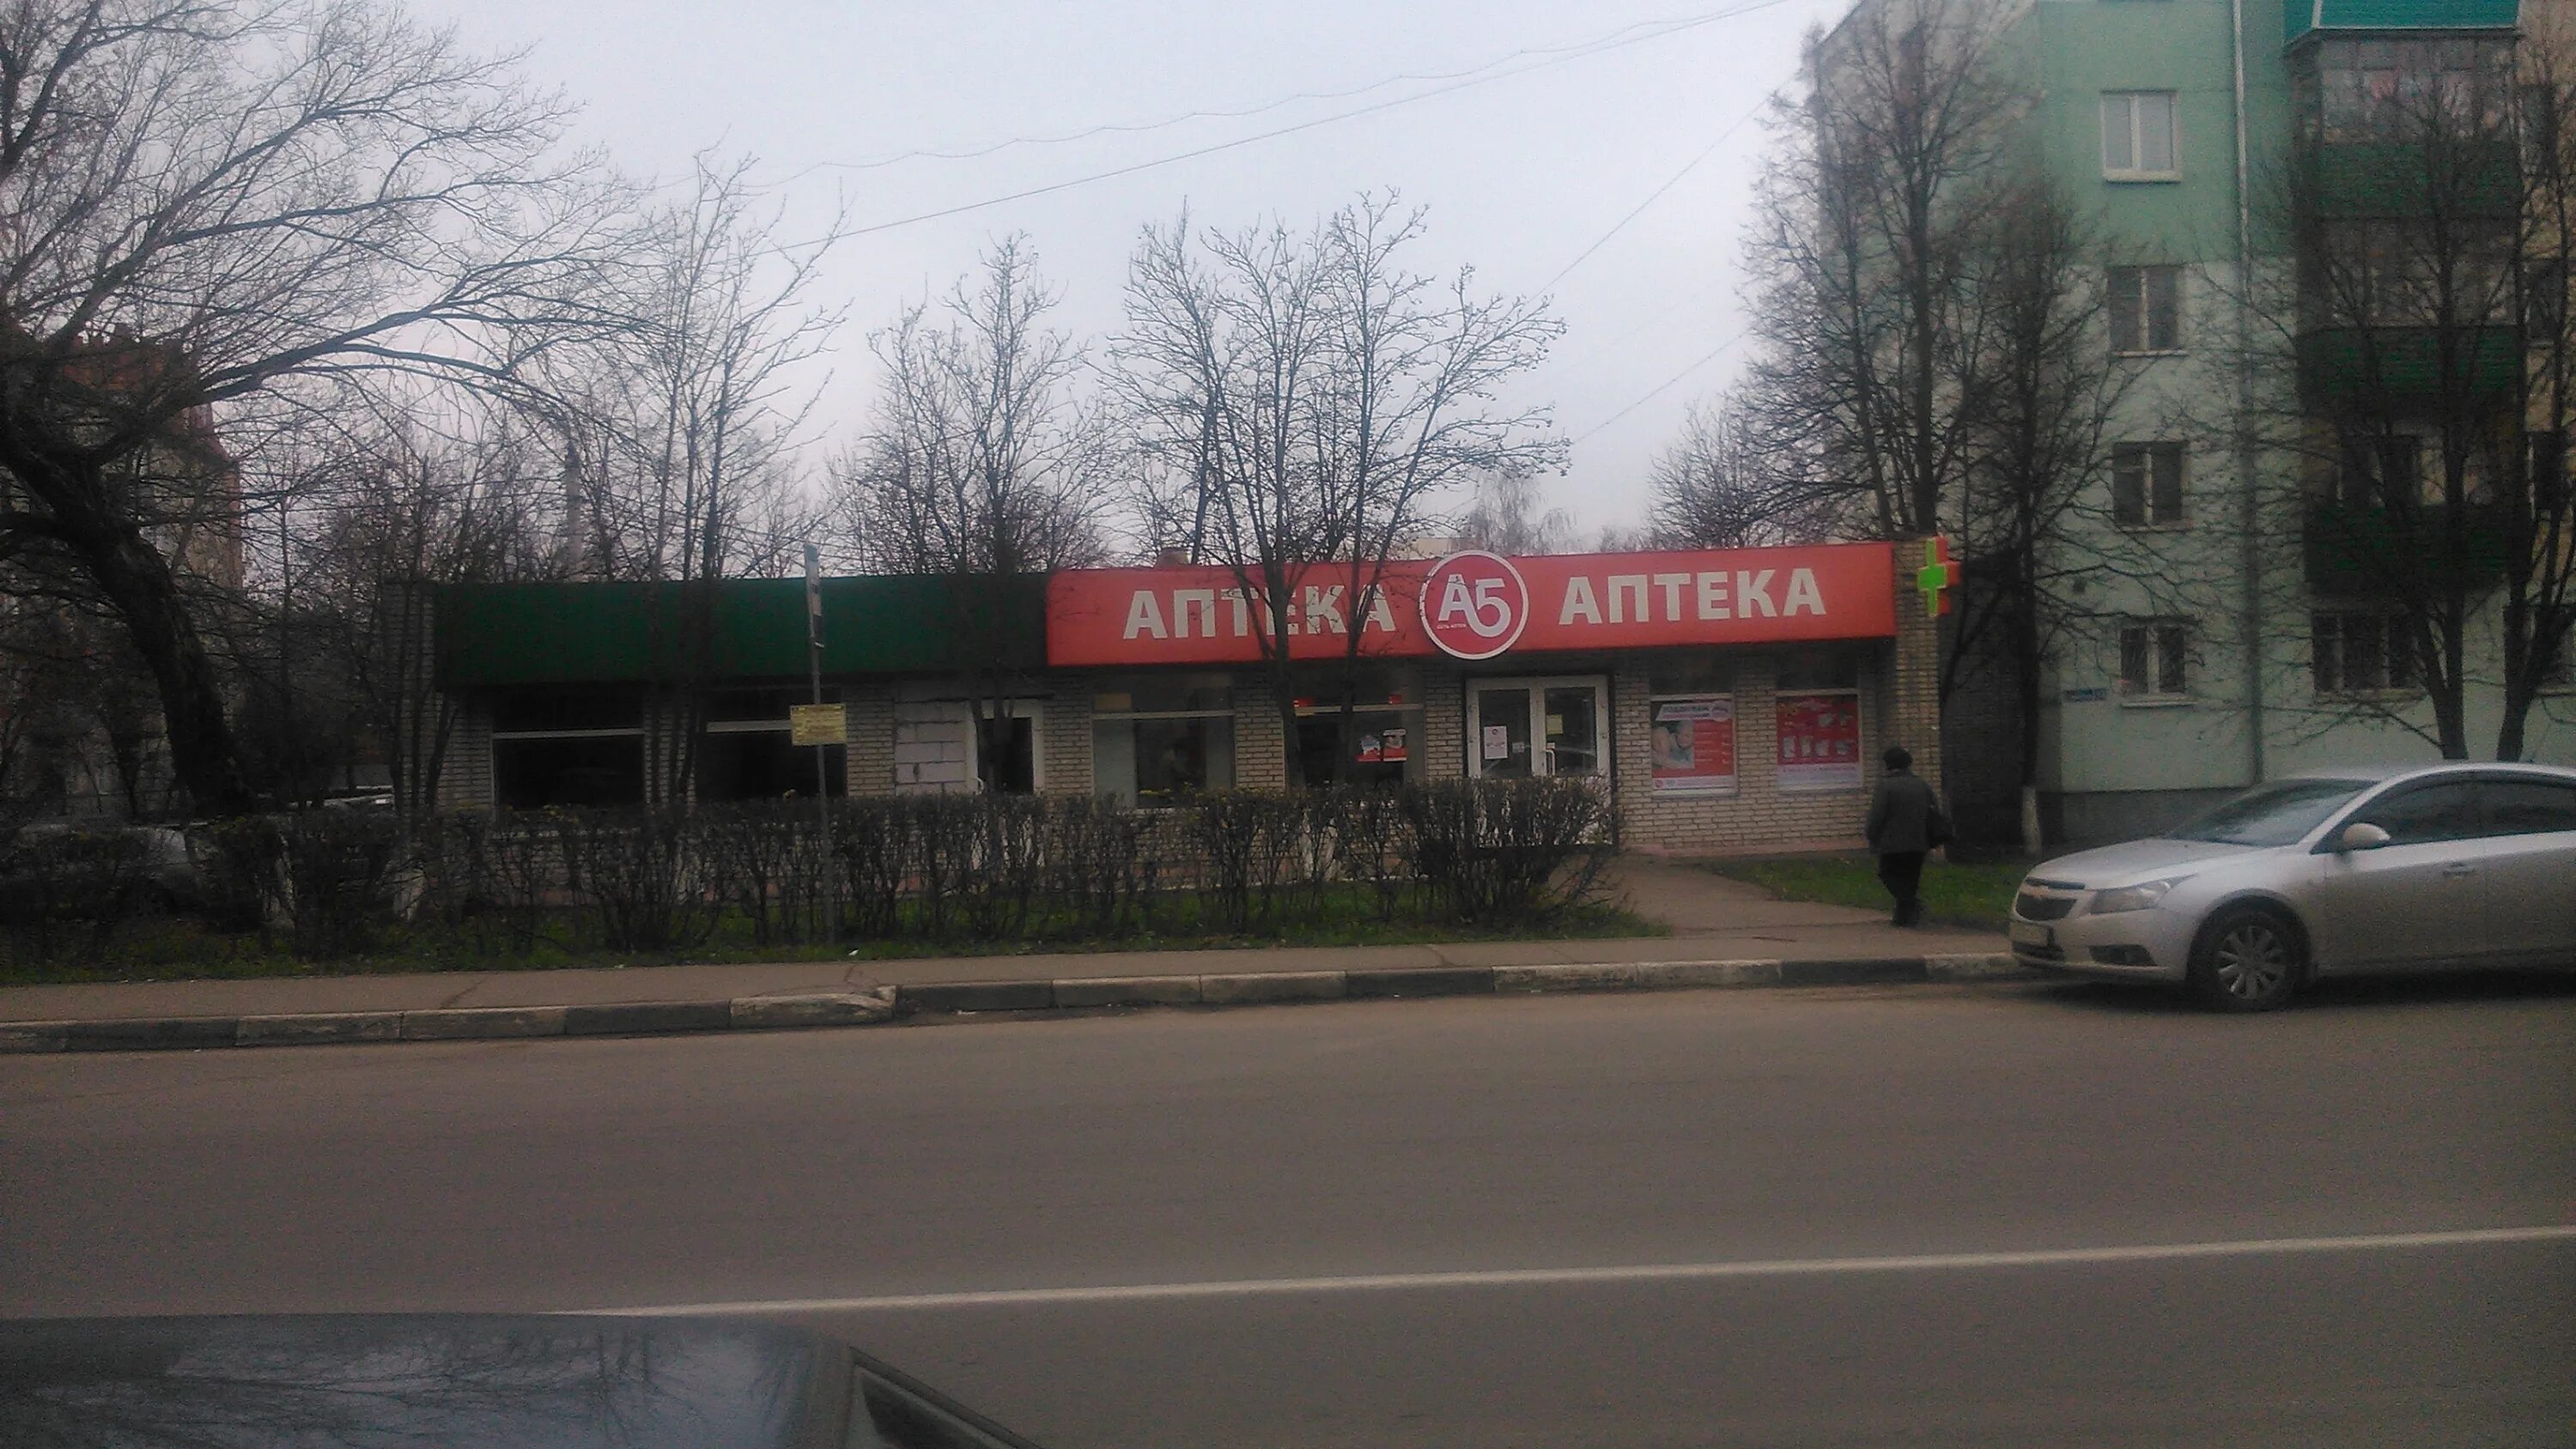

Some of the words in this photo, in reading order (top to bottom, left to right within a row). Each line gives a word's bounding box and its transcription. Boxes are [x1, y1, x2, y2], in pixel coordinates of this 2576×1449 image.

[1123, 584, 1396, 639] АПТЕКА
[1438, 573, 1511, 637] А5
[1558, 568, 1826, 625] АПТЕКА
